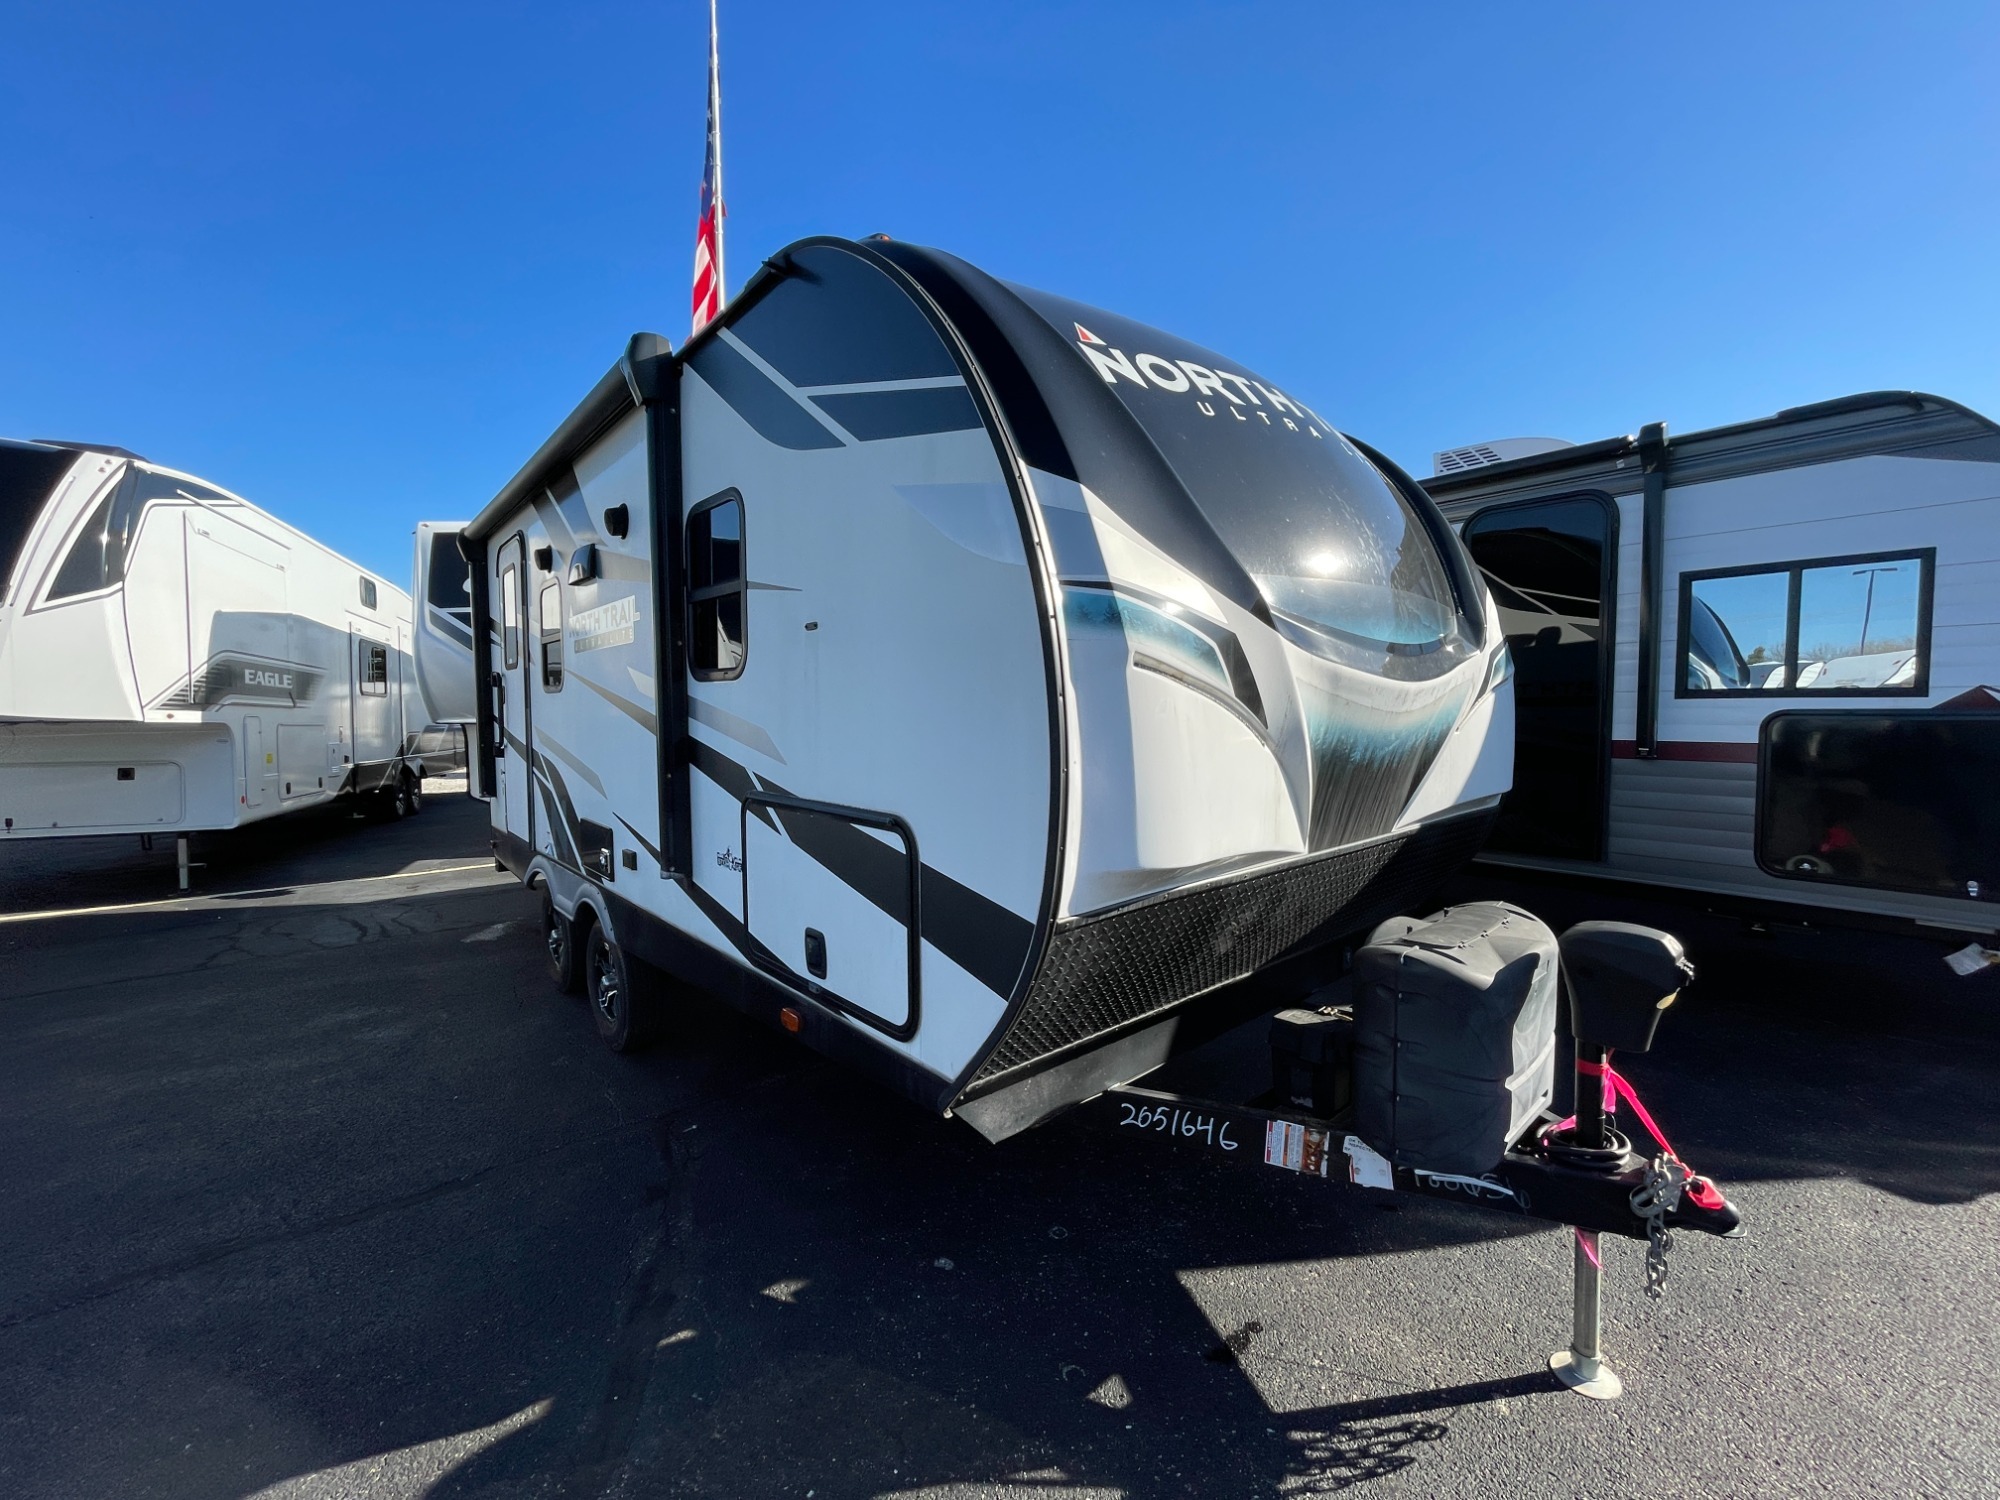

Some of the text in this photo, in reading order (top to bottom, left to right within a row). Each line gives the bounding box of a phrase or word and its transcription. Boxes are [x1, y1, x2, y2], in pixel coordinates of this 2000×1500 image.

[1076, 340, 1304, 418] NORTH
[1197, 401, 1323, 440] ULTRA
[568, 597, 640, 638] NORTH TRAIL
[244, 668, 293, 689] EAGLE
